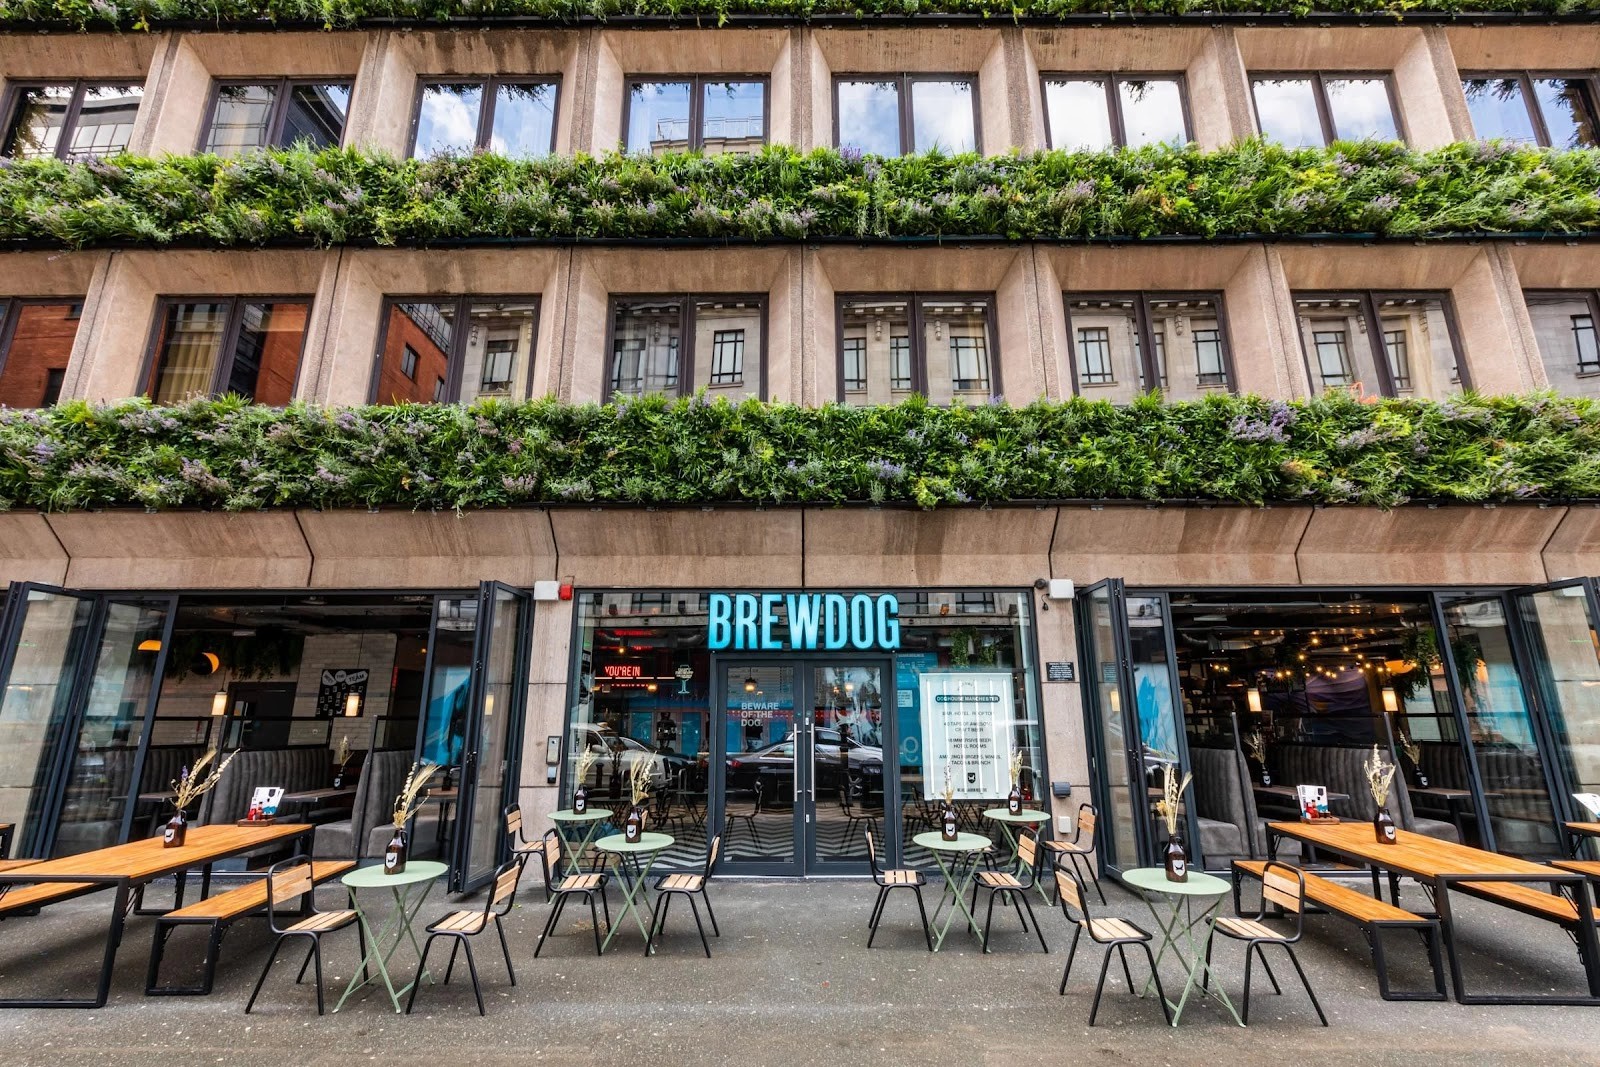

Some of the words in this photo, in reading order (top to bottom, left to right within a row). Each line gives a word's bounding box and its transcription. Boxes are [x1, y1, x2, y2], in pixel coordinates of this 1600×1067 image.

[708, 593, 900, 650] BREWDOG
[348, 673, 364, 682] TEAM
[741, 702, 780, 710] BEWARE
